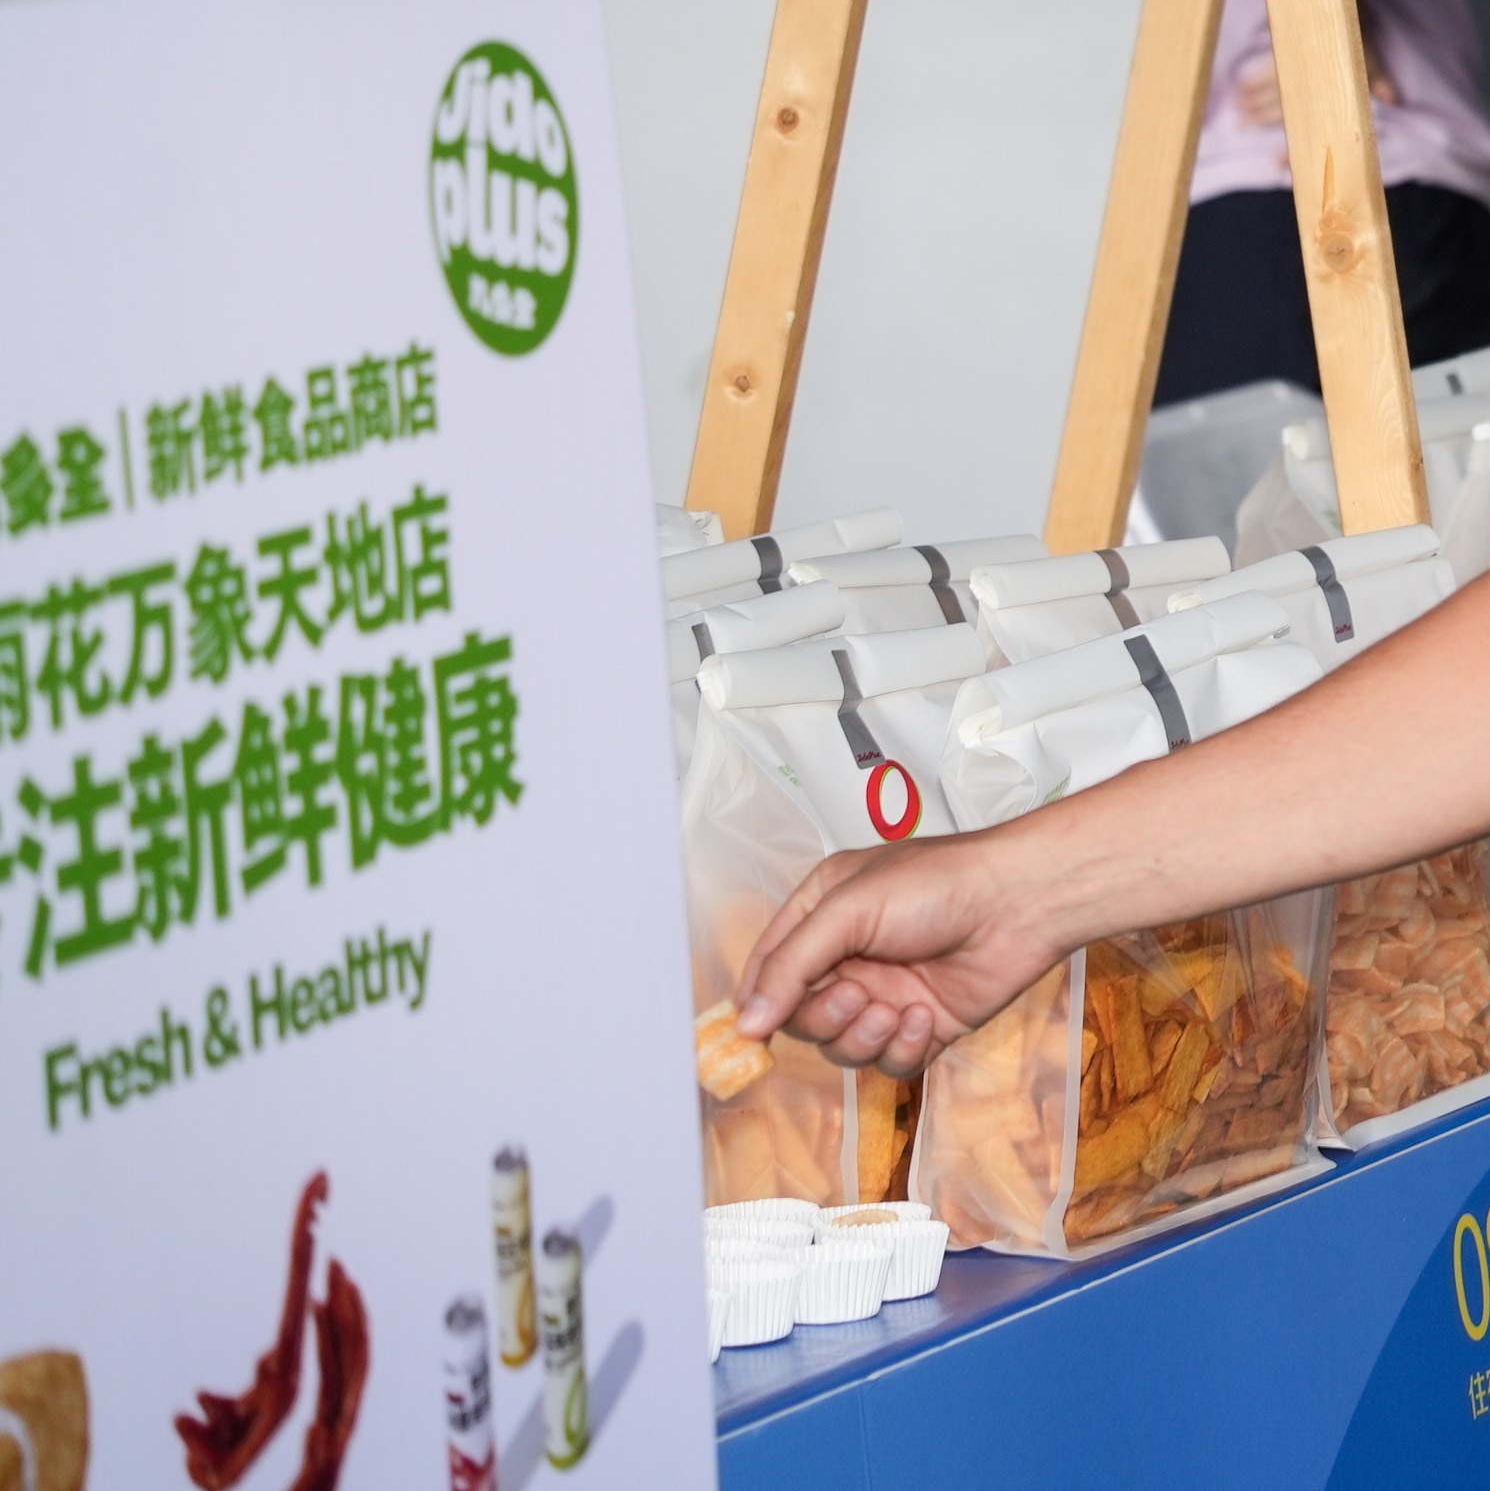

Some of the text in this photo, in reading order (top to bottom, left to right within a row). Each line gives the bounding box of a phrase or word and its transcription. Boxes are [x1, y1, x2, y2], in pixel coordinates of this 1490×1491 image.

[434, 142, 569, 276] plus
[0, 630, 524, 986] 注新鲜健康
[45, 926, 431, 1132] Fresh & Healthy
